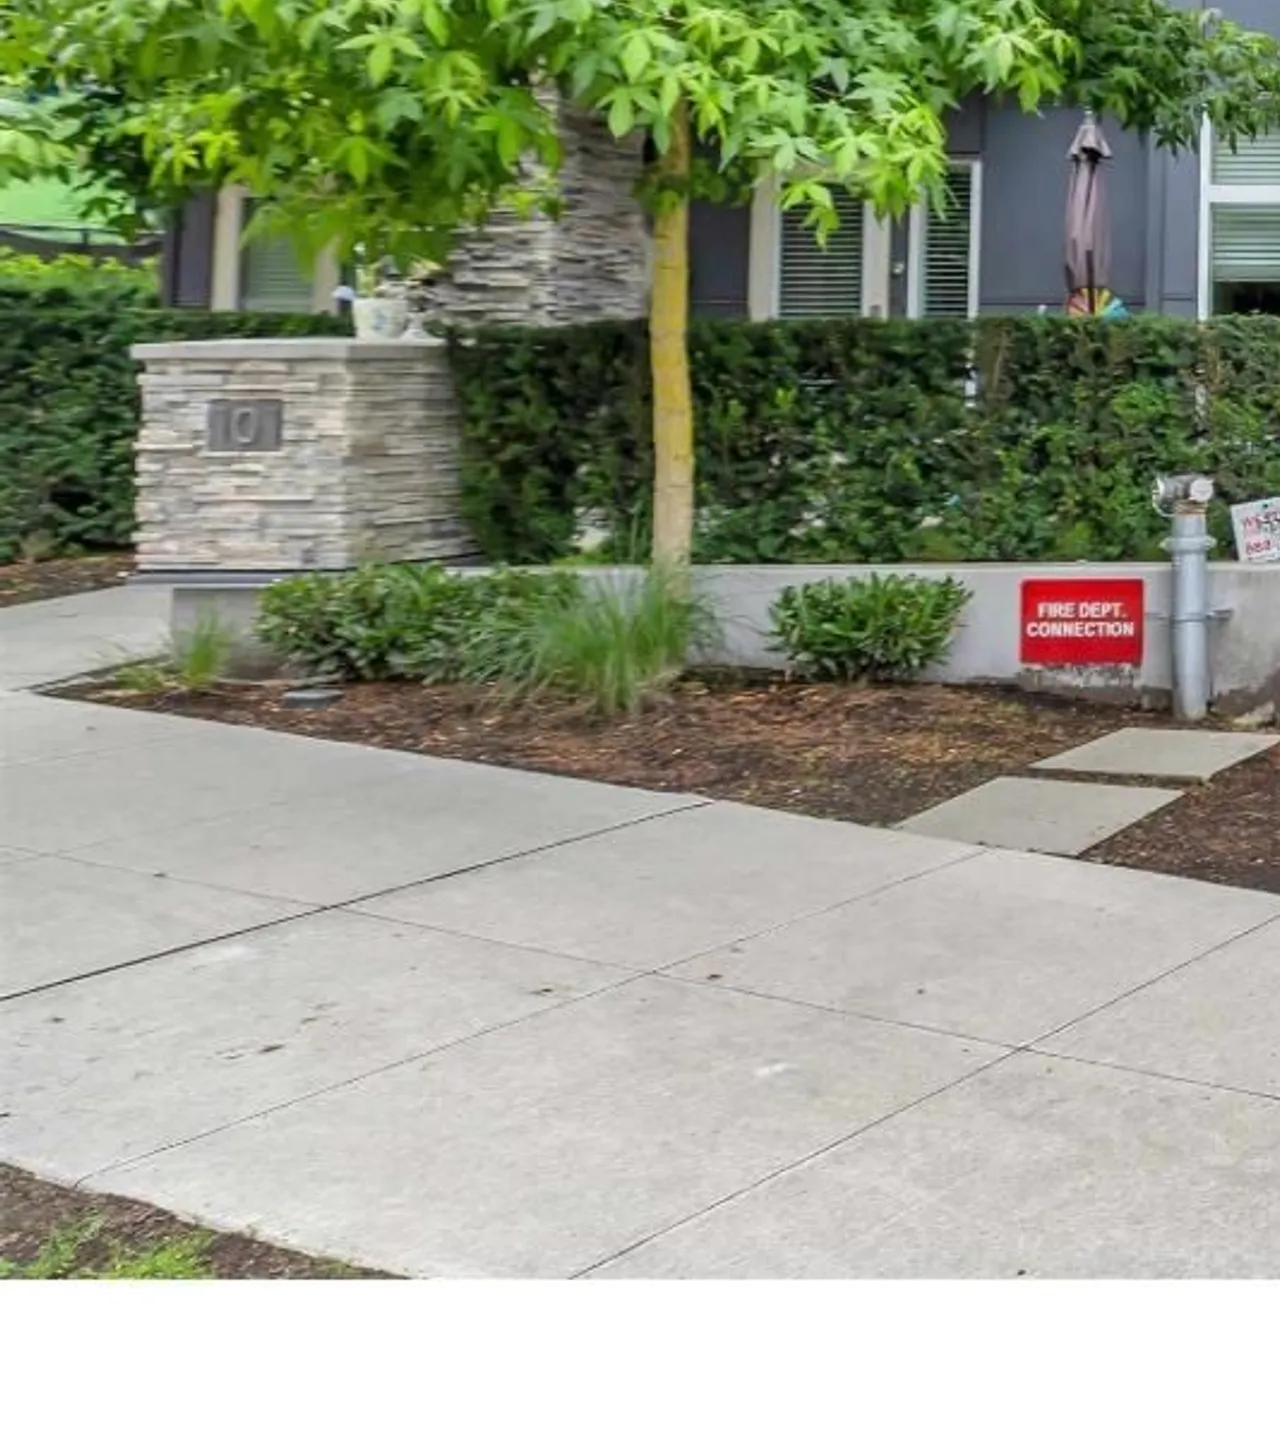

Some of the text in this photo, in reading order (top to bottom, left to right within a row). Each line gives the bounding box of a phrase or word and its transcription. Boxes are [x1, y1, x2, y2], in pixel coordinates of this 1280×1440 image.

[1037, 602, 1127, 618] FIRE DEPT.
[1026, 622, 1134, 637] CONNECTION
